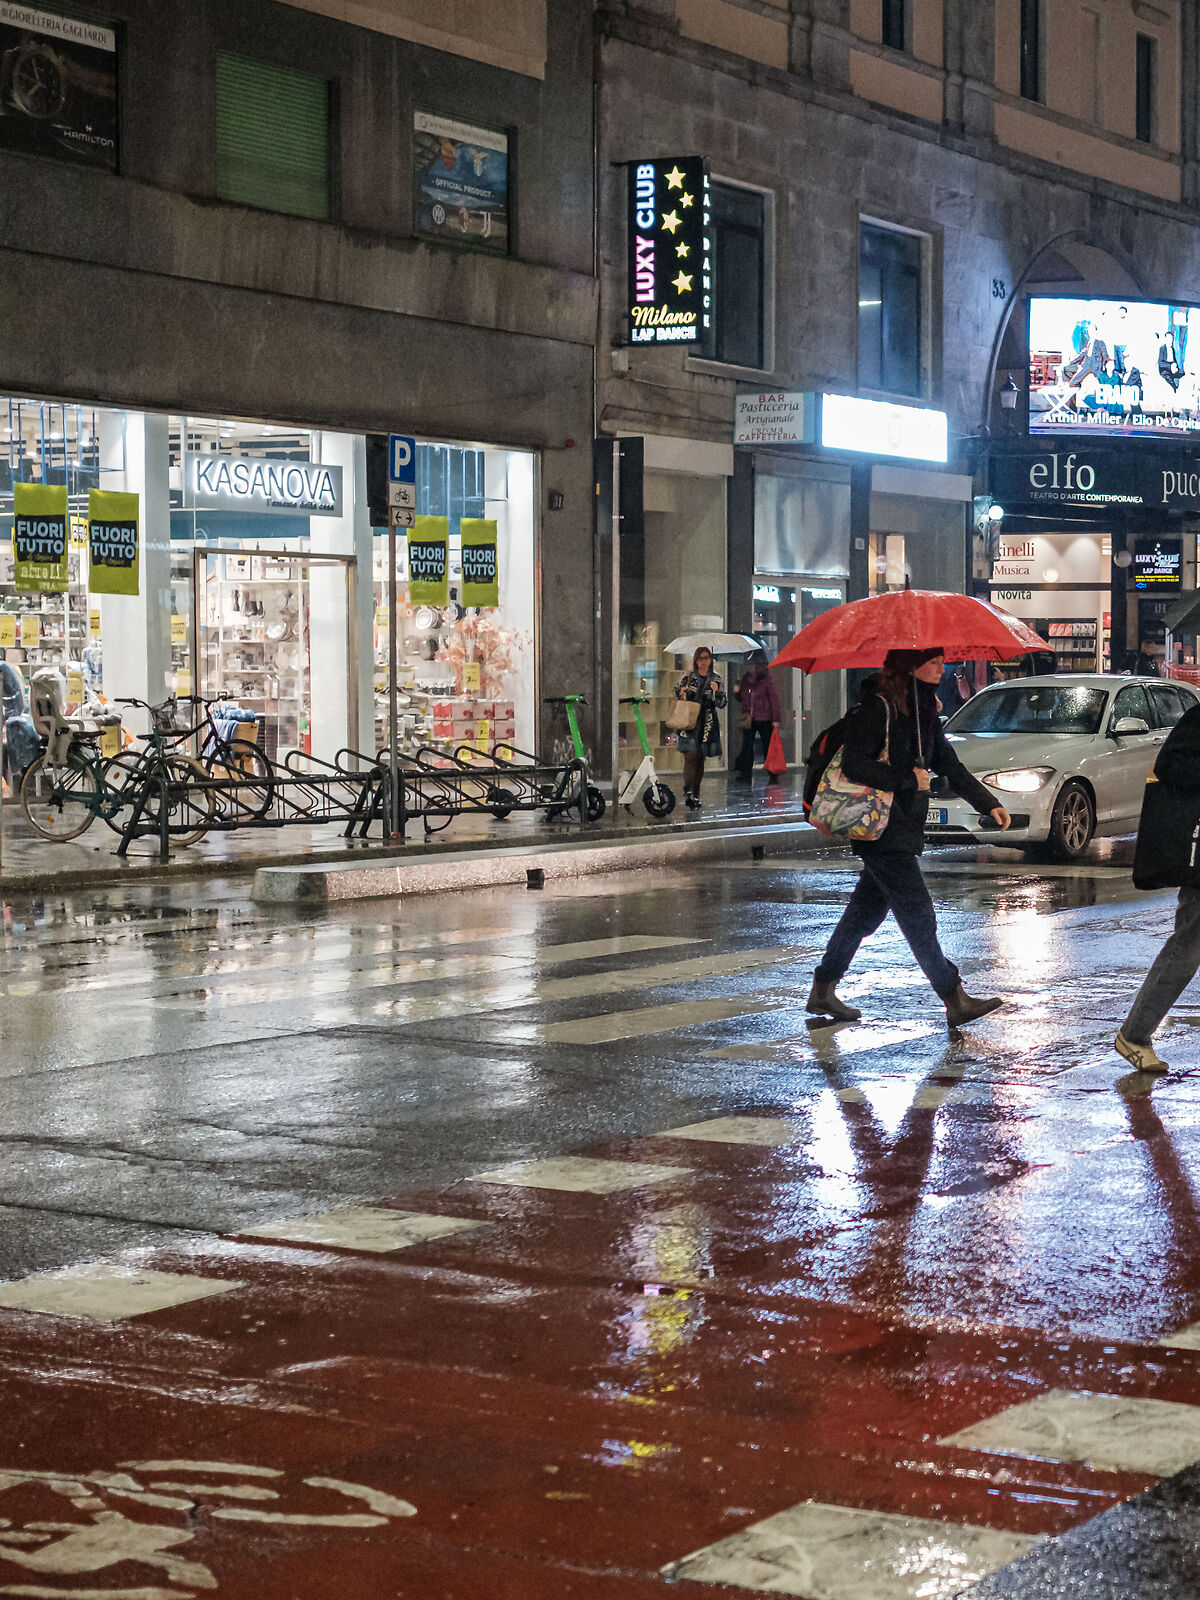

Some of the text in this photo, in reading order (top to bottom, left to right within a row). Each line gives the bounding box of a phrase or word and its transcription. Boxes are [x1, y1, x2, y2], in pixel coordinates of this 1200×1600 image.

[9, 8, 106, 43] GIOIELLERIA GAGLIARDI
[63, 130, 114, 147] HAMILTON
[435, 178, 492, 198] OFFICIAL PRODUCT
[635, 163, 656, 302] LUXY CLUB
[992, 278, 1005, 299] 33
[631, 303, 697, 327] Milano
[632, 326, 696, 341] LAP DANCE
[758, 394, 785, 402] BAR
[740, 402, 800, 413] Pasticceria
[743, 413, 795, 426] Artigianale
[1042, 411, 1084, 423] Arthur
[1086, 412, 1121, 425] Miller
[1132, 414, 1154, 426] Elio
[1156, 416, 1170, 427] De
[739, 433, 797, 441] CAFFETTERIA
[394, 440, 411, 478] P
[195, 459, 337, 502] KASANOVA
[1029, 454, 1096, 491] elfo
[1030, 492, 1143, 503] TEATRO D'ARTE CONTEMPORANEA
[17, 521, 64, 538] FUORI
[91, 526, 136, 543] FUORI
[17, 538, 64, 554] TUTTO
[92, 542, 136, 559] TUTTO
[410, 546, 444, 560] FUORI
[463, 550, 495, 562] FUORI
[1135, 554, 1156, 563] LUXY
[410, 561, 445, 574] TUTTO
[463, 563, 495, 576] TUTTO
[994, 565, 1030, 575] Musica
